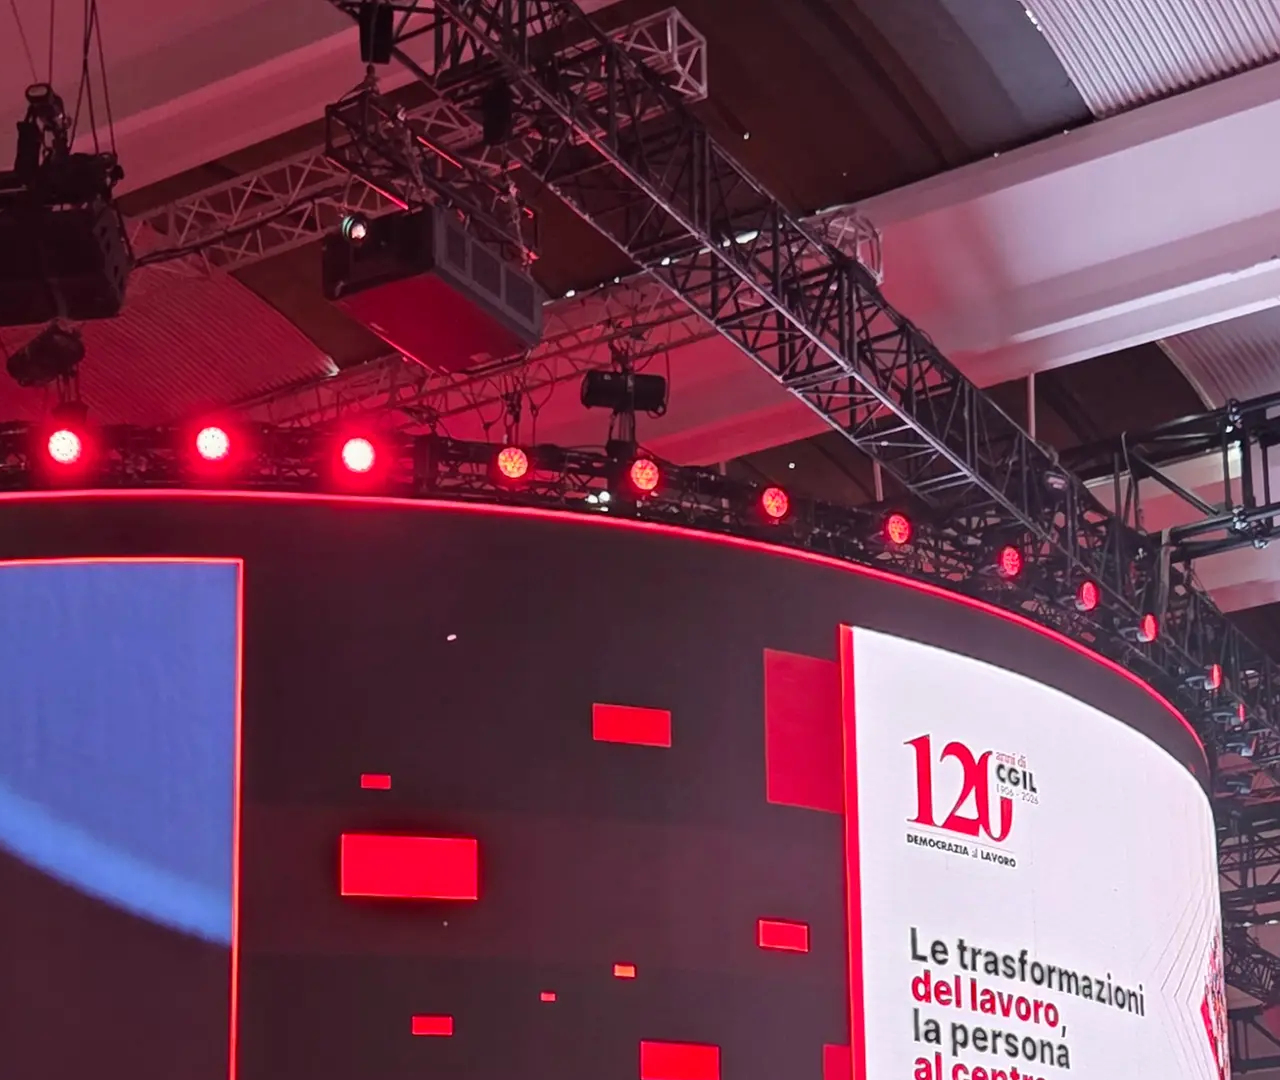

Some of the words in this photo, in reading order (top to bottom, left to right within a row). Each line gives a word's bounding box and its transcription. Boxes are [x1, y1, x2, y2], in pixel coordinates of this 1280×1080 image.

[903, 734, 1013, 842] 120
[996, 763, 1037, 794] CGIL
[906, 833, 969, 856] DEMOCRAZIA
[980, 849, 1017, 868] LAVORO
[910, 927, 949, 965] Le
[957, 938, 1146, 1017] trasformazioni
[911, 969, 962, 1008] del
[970, 977, 1067, 1038] lavoro,
[913, 1008, 942, 1045] la
[951, 1022, 1070, 1069] persona
